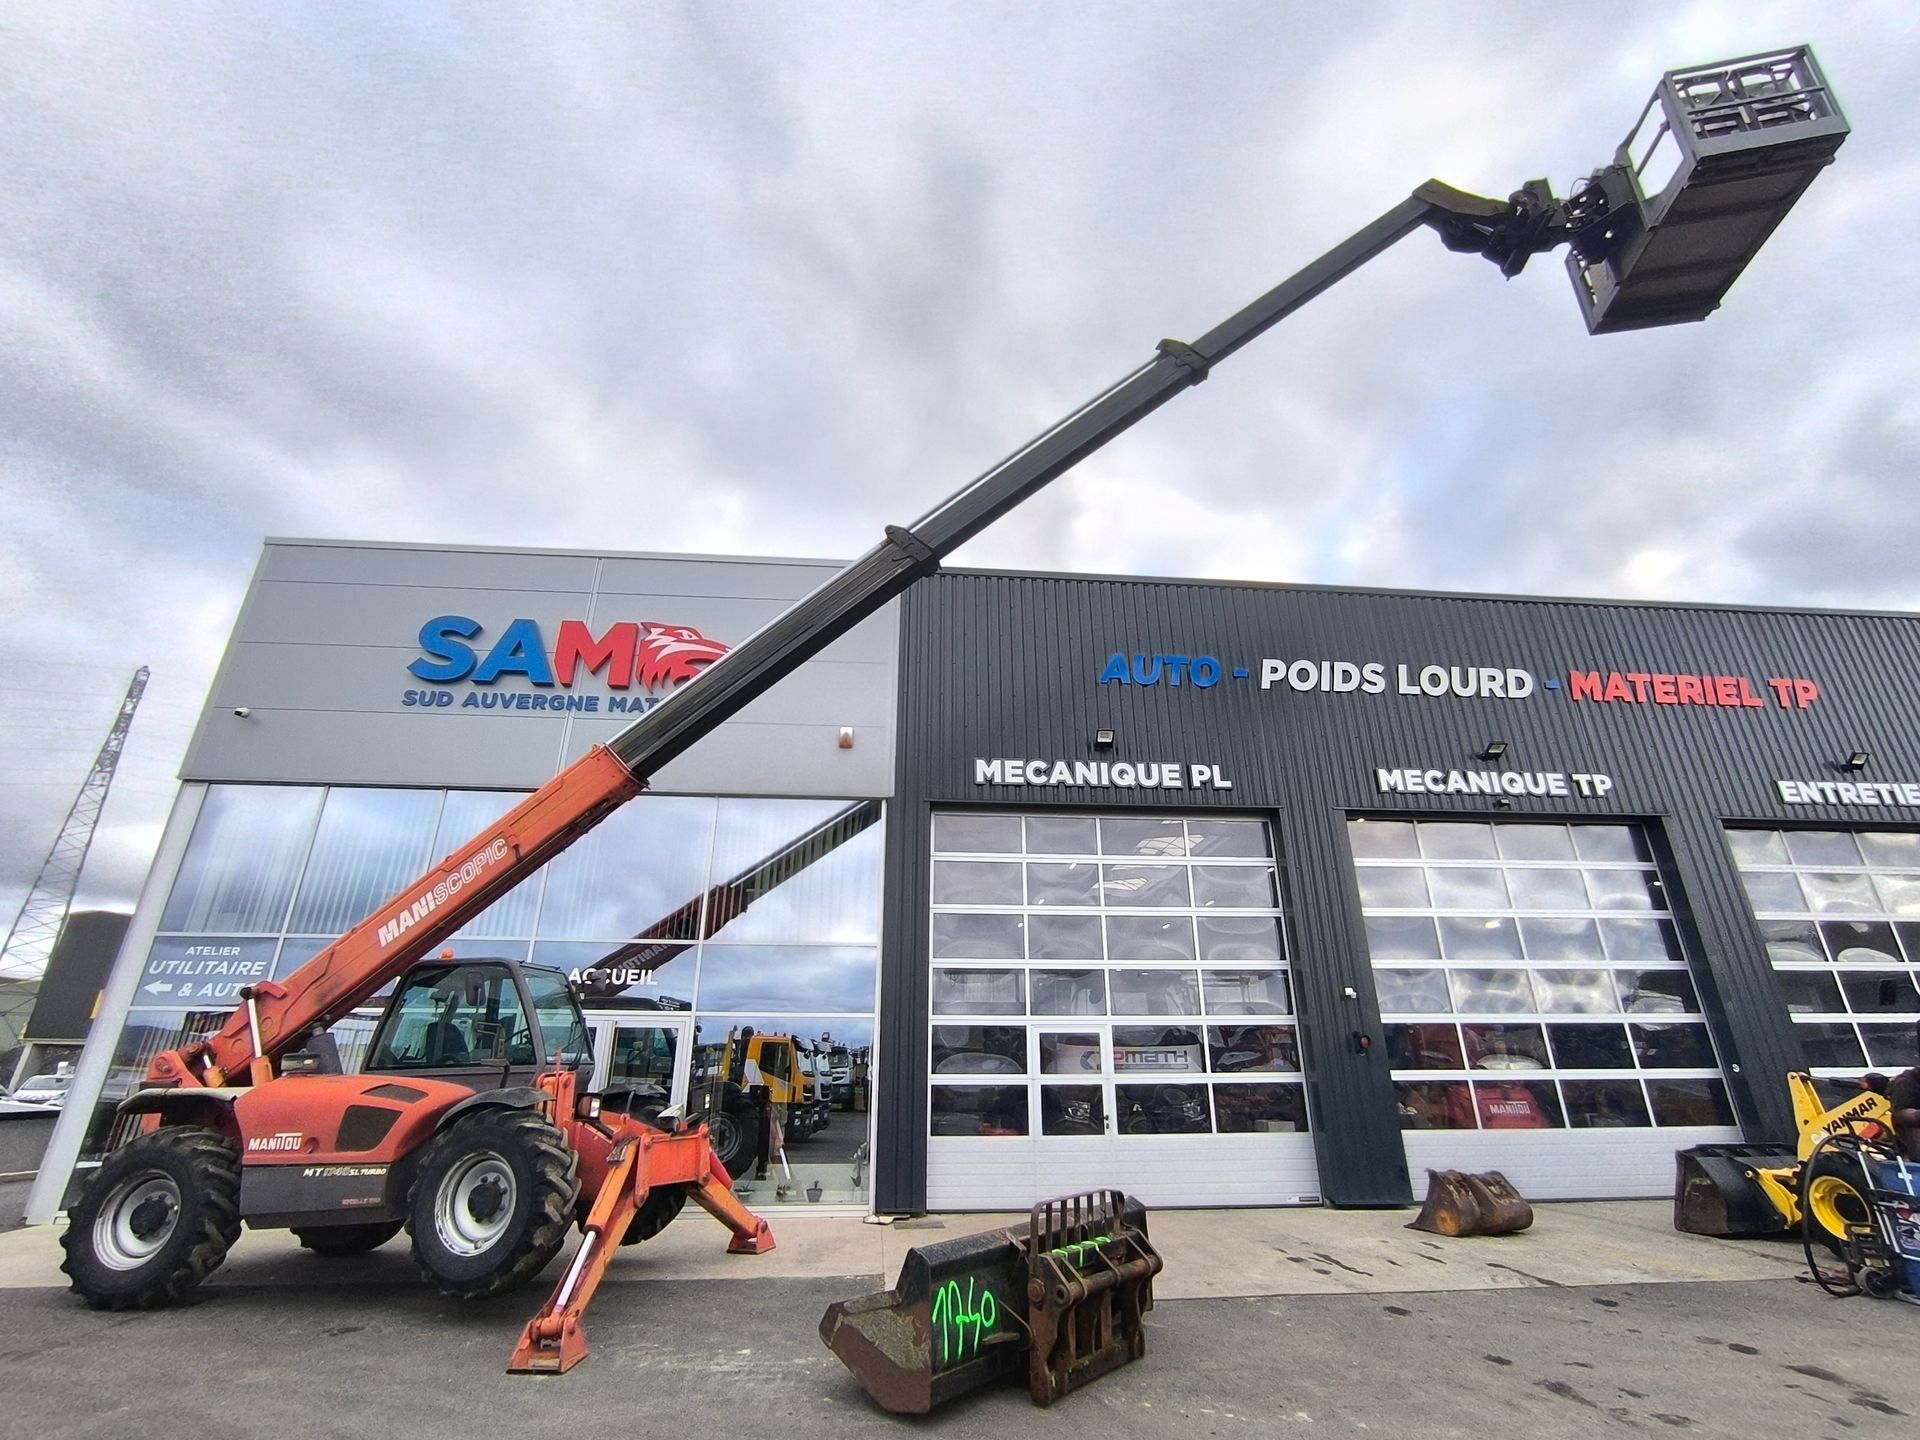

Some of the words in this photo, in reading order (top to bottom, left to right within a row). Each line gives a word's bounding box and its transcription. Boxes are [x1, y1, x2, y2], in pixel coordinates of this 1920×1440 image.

[407, 615, 639, 689] SAM
[1100, 652, 1222, 688] AUTO
[1261, 658, 1385, 694] POIDS
[1397, 664, 1533, 698] LOURD
[1570, 670, 1764, 708] MATERIEL
[1767, 677, 1820, 709] TP
[402, 690, 453, 707] SUD
[461, 691, 599, 712] AUVERGNE
[608, 696, 665, 713] MAT
[975, 758, 1183, 788] MECANIQUE
[1190, 764, 1232, 788] PL
[1376, 768, 1569, 796] MECANIQUE
[1572, 773, 1612, 797] TP
[1778, 780, 1920, 806] ENTRETIE
[377, 838, 508, 948] MANISCOPIC
[185, 946, 241, 956] ATELIER
[149, 960, 268, 976] UTILITAIRE
[178, 982, 193, 997] &
[196, 982, 254, 997] AUT
[1489, 1101, 1531, 1114] MANITOU
[1822, 1097, 1878, 1135] YANMAR
[248, 1132, 303, 1151] MANITOU
